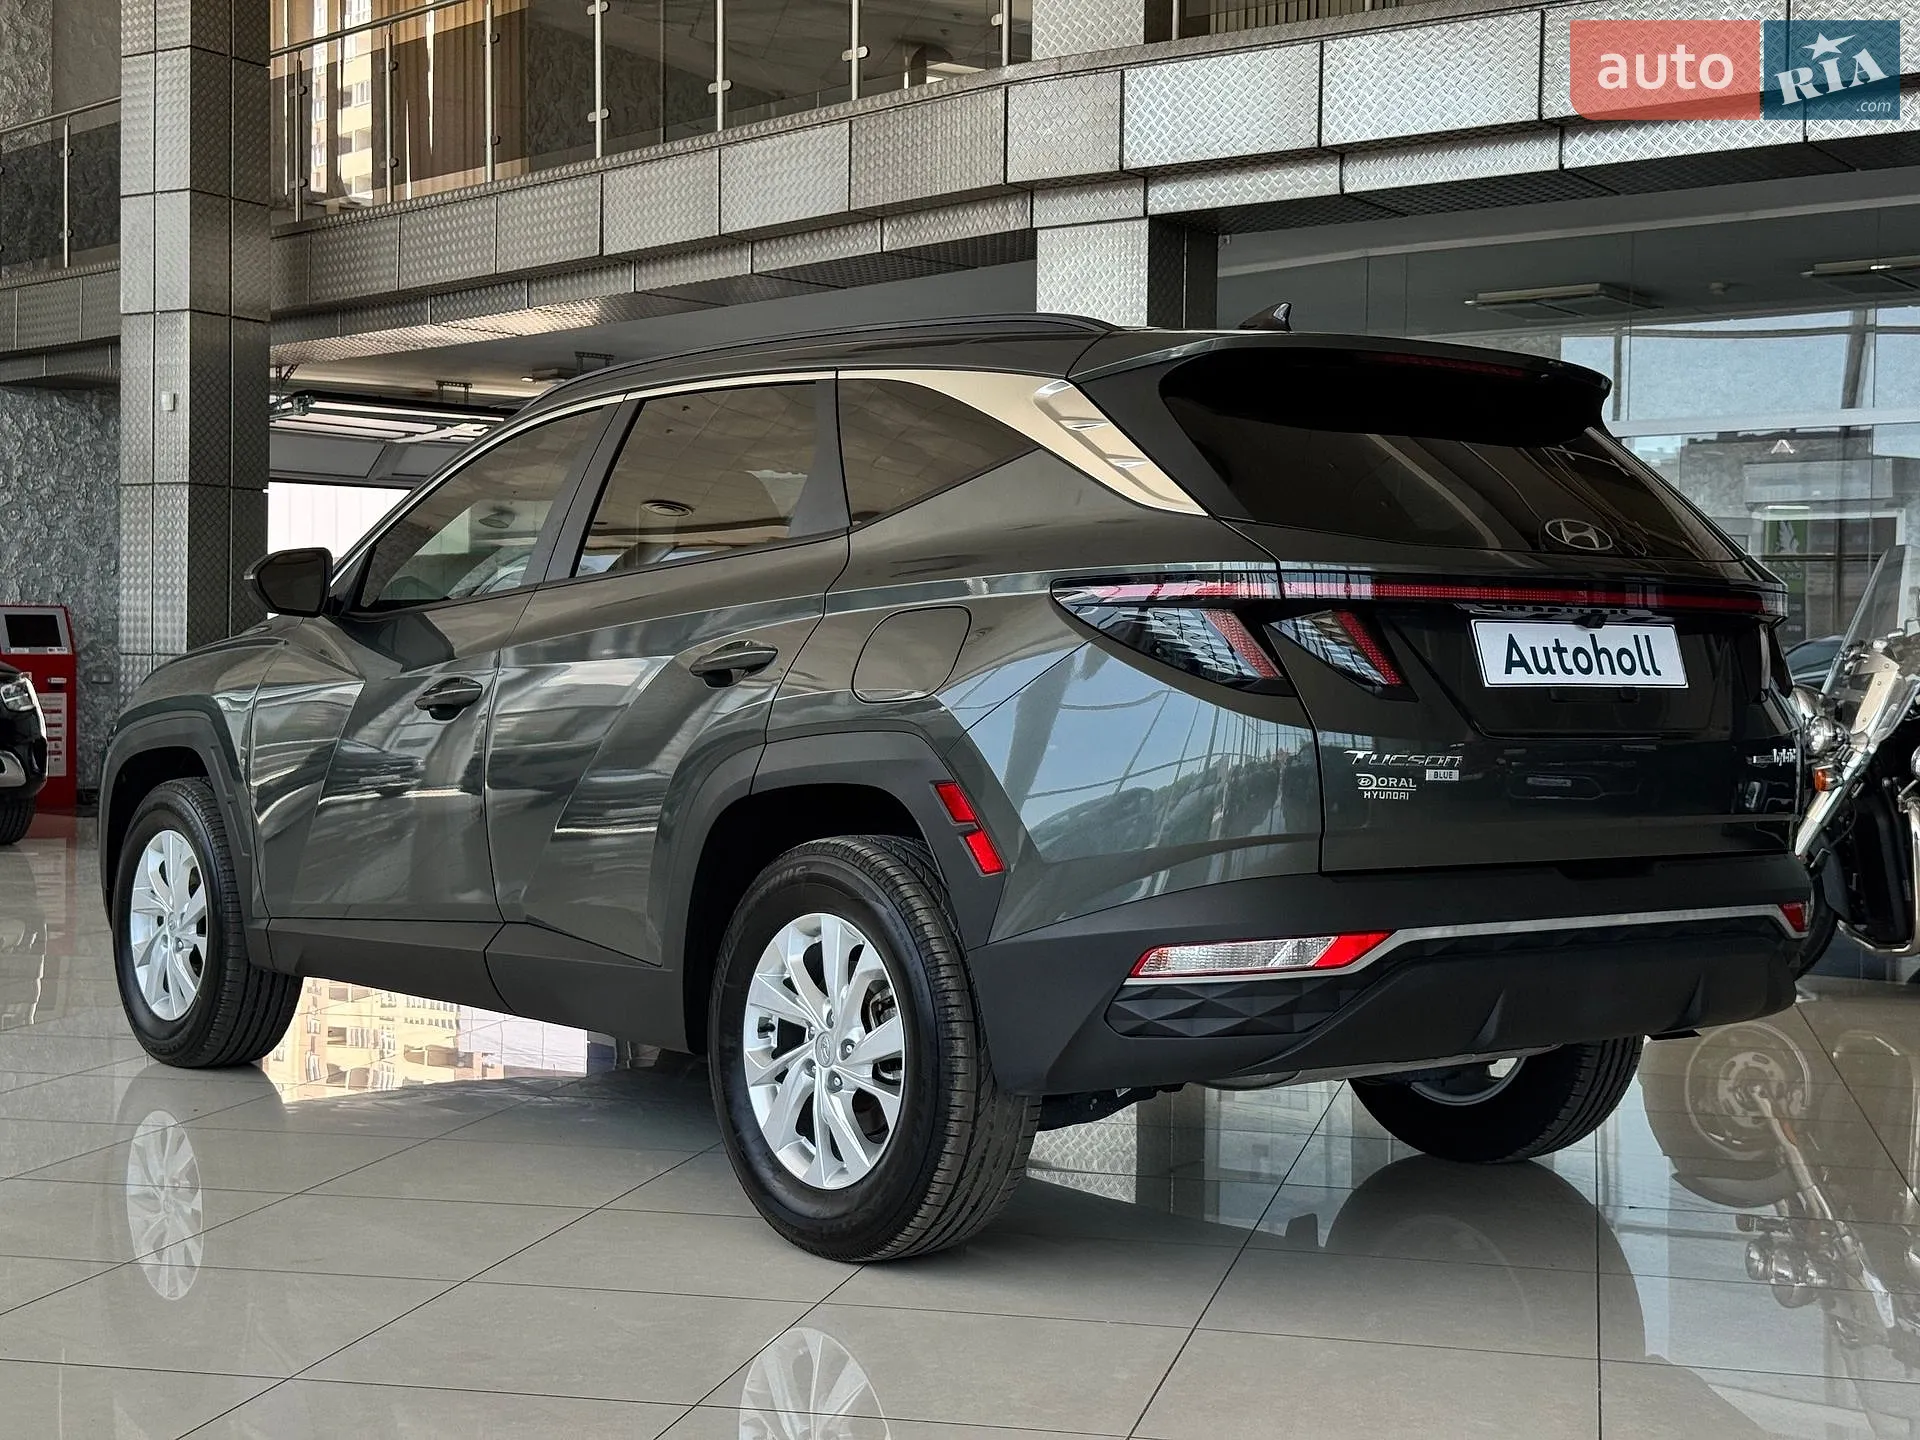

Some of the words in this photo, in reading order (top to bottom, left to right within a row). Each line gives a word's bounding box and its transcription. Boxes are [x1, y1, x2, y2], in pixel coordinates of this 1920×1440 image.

[1504, 633, 1662, 676] Autoholl
[1433, 770, 1453, 779] BLUE
[1356, 773, 1416, 789] DORAL
[1363, 791, 1409, 800] HYUNDAI
